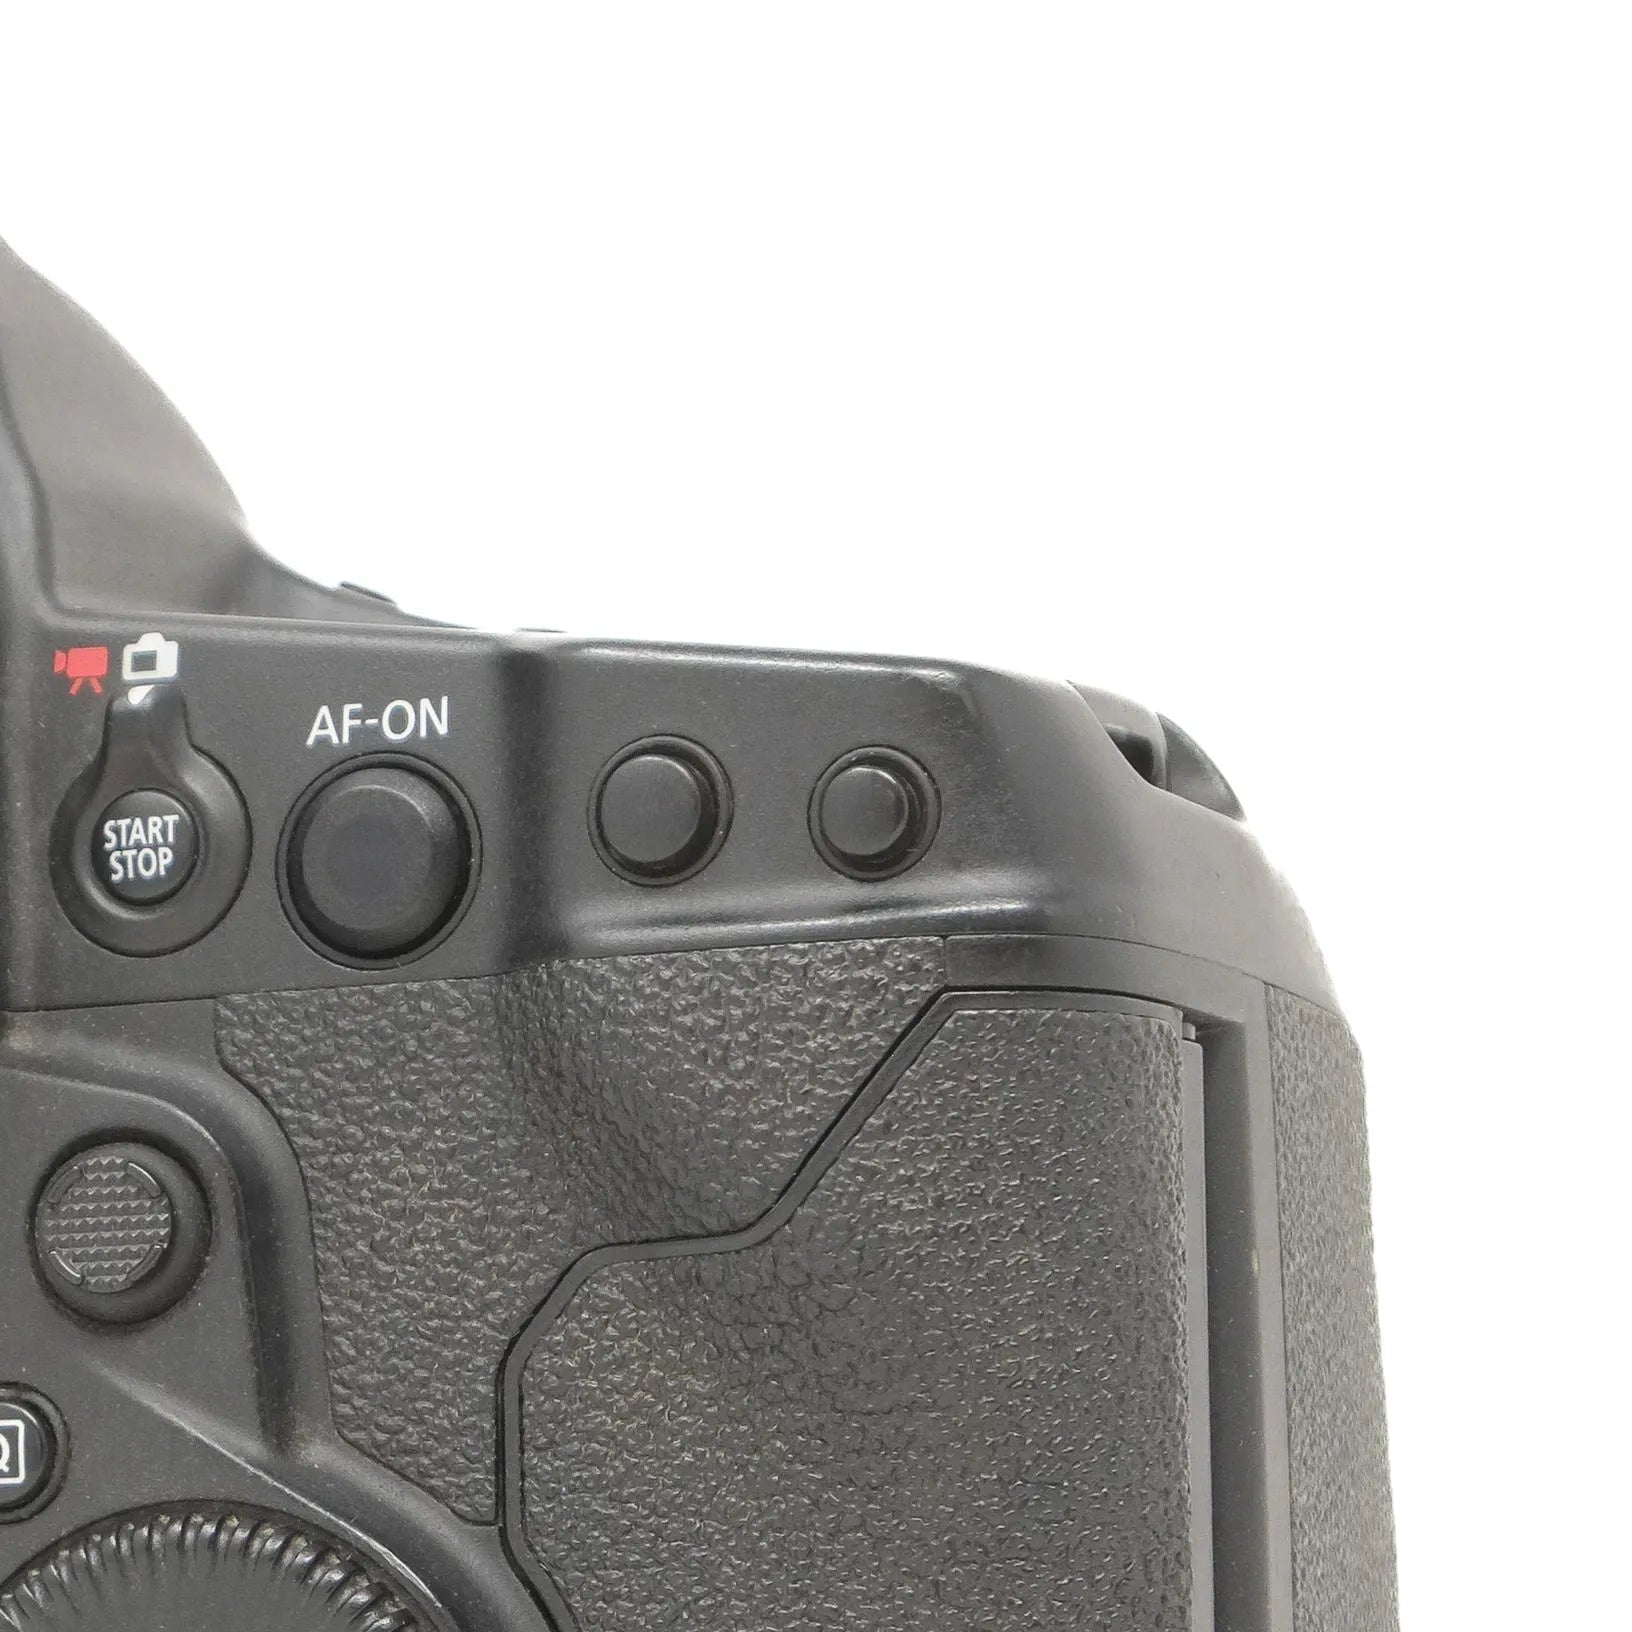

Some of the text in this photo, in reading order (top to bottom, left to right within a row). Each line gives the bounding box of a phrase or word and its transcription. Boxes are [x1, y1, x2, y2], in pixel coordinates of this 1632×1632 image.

[306, 696, 449, 746] AF-ON
[103, 814, 179, 851] START
[109, 847, 173, 882] STOP
